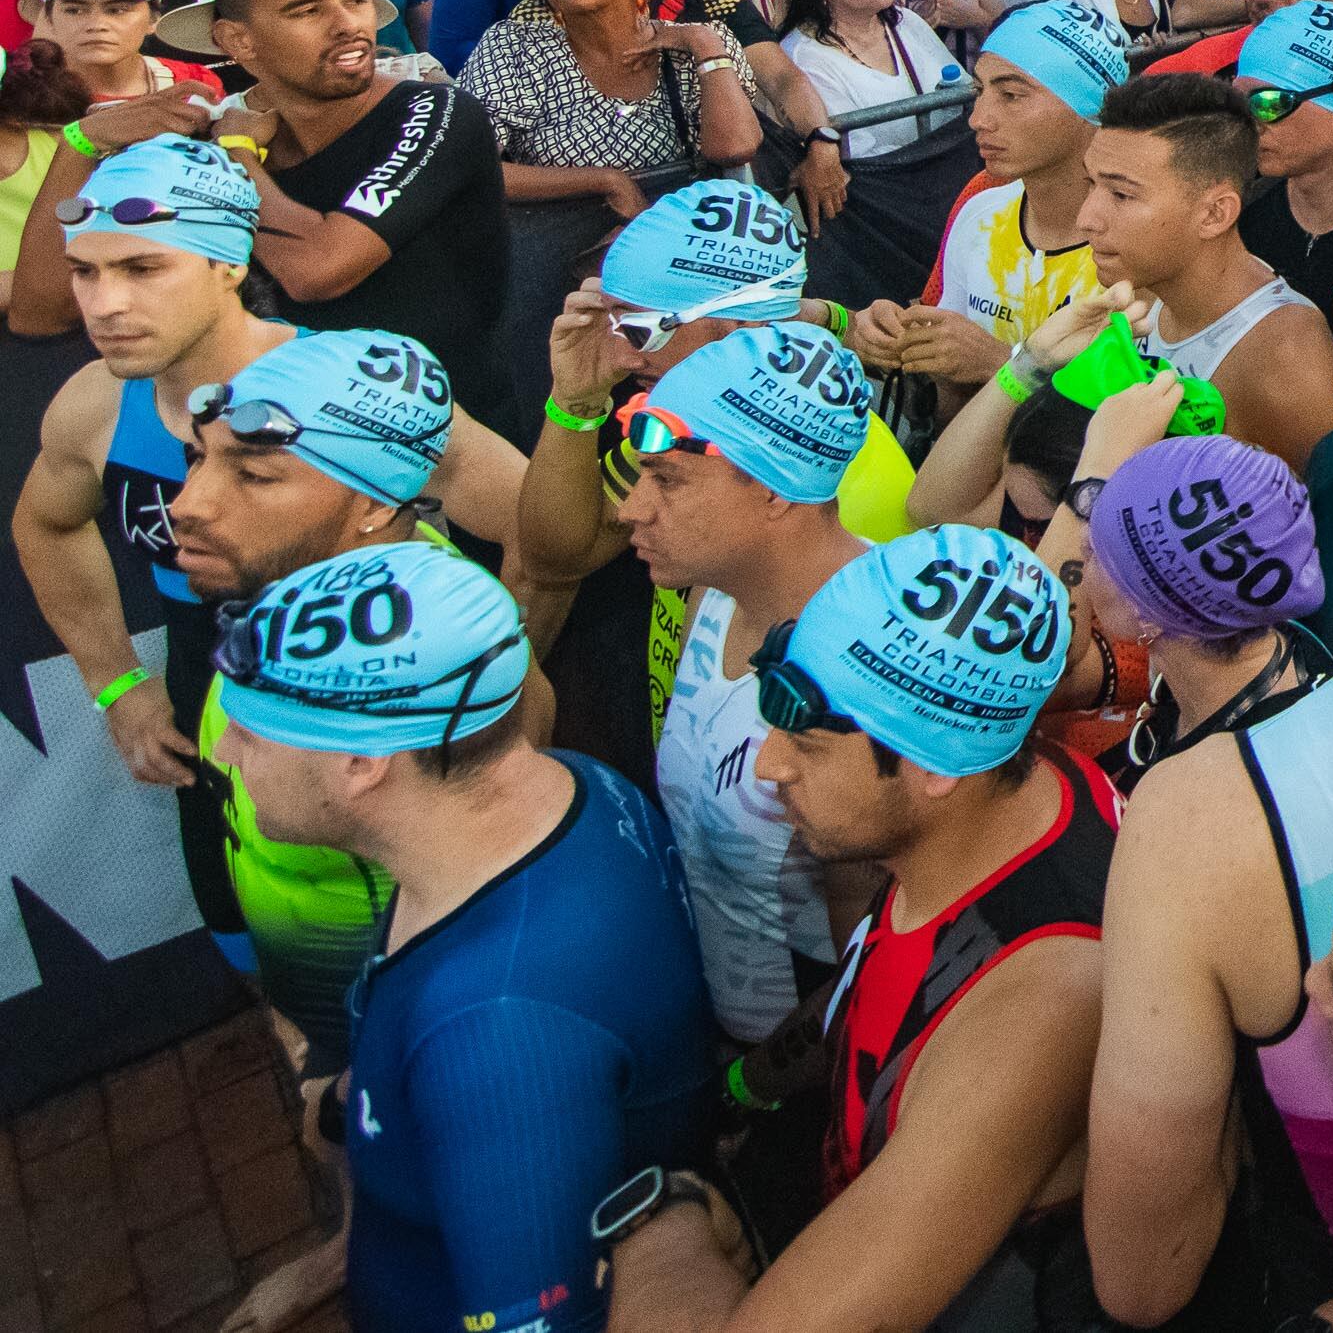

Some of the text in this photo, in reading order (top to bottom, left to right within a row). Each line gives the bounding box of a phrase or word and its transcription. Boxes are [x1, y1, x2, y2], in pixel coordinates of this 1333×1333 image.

[968, 294, 1015, 323] MIGUEL
[723, 391, 795, 440] CARTAGENA
[750, 389, 846, 446] COLOMBIA
[902, 558, 1059, 664] 5i50
[850, 639, 947, 708] CARTAGENA
[953, 699, 974, 714] DE
[882, 642, 1020, 706] COLOMBIA
[912, 705, 979, 734] Heineken
